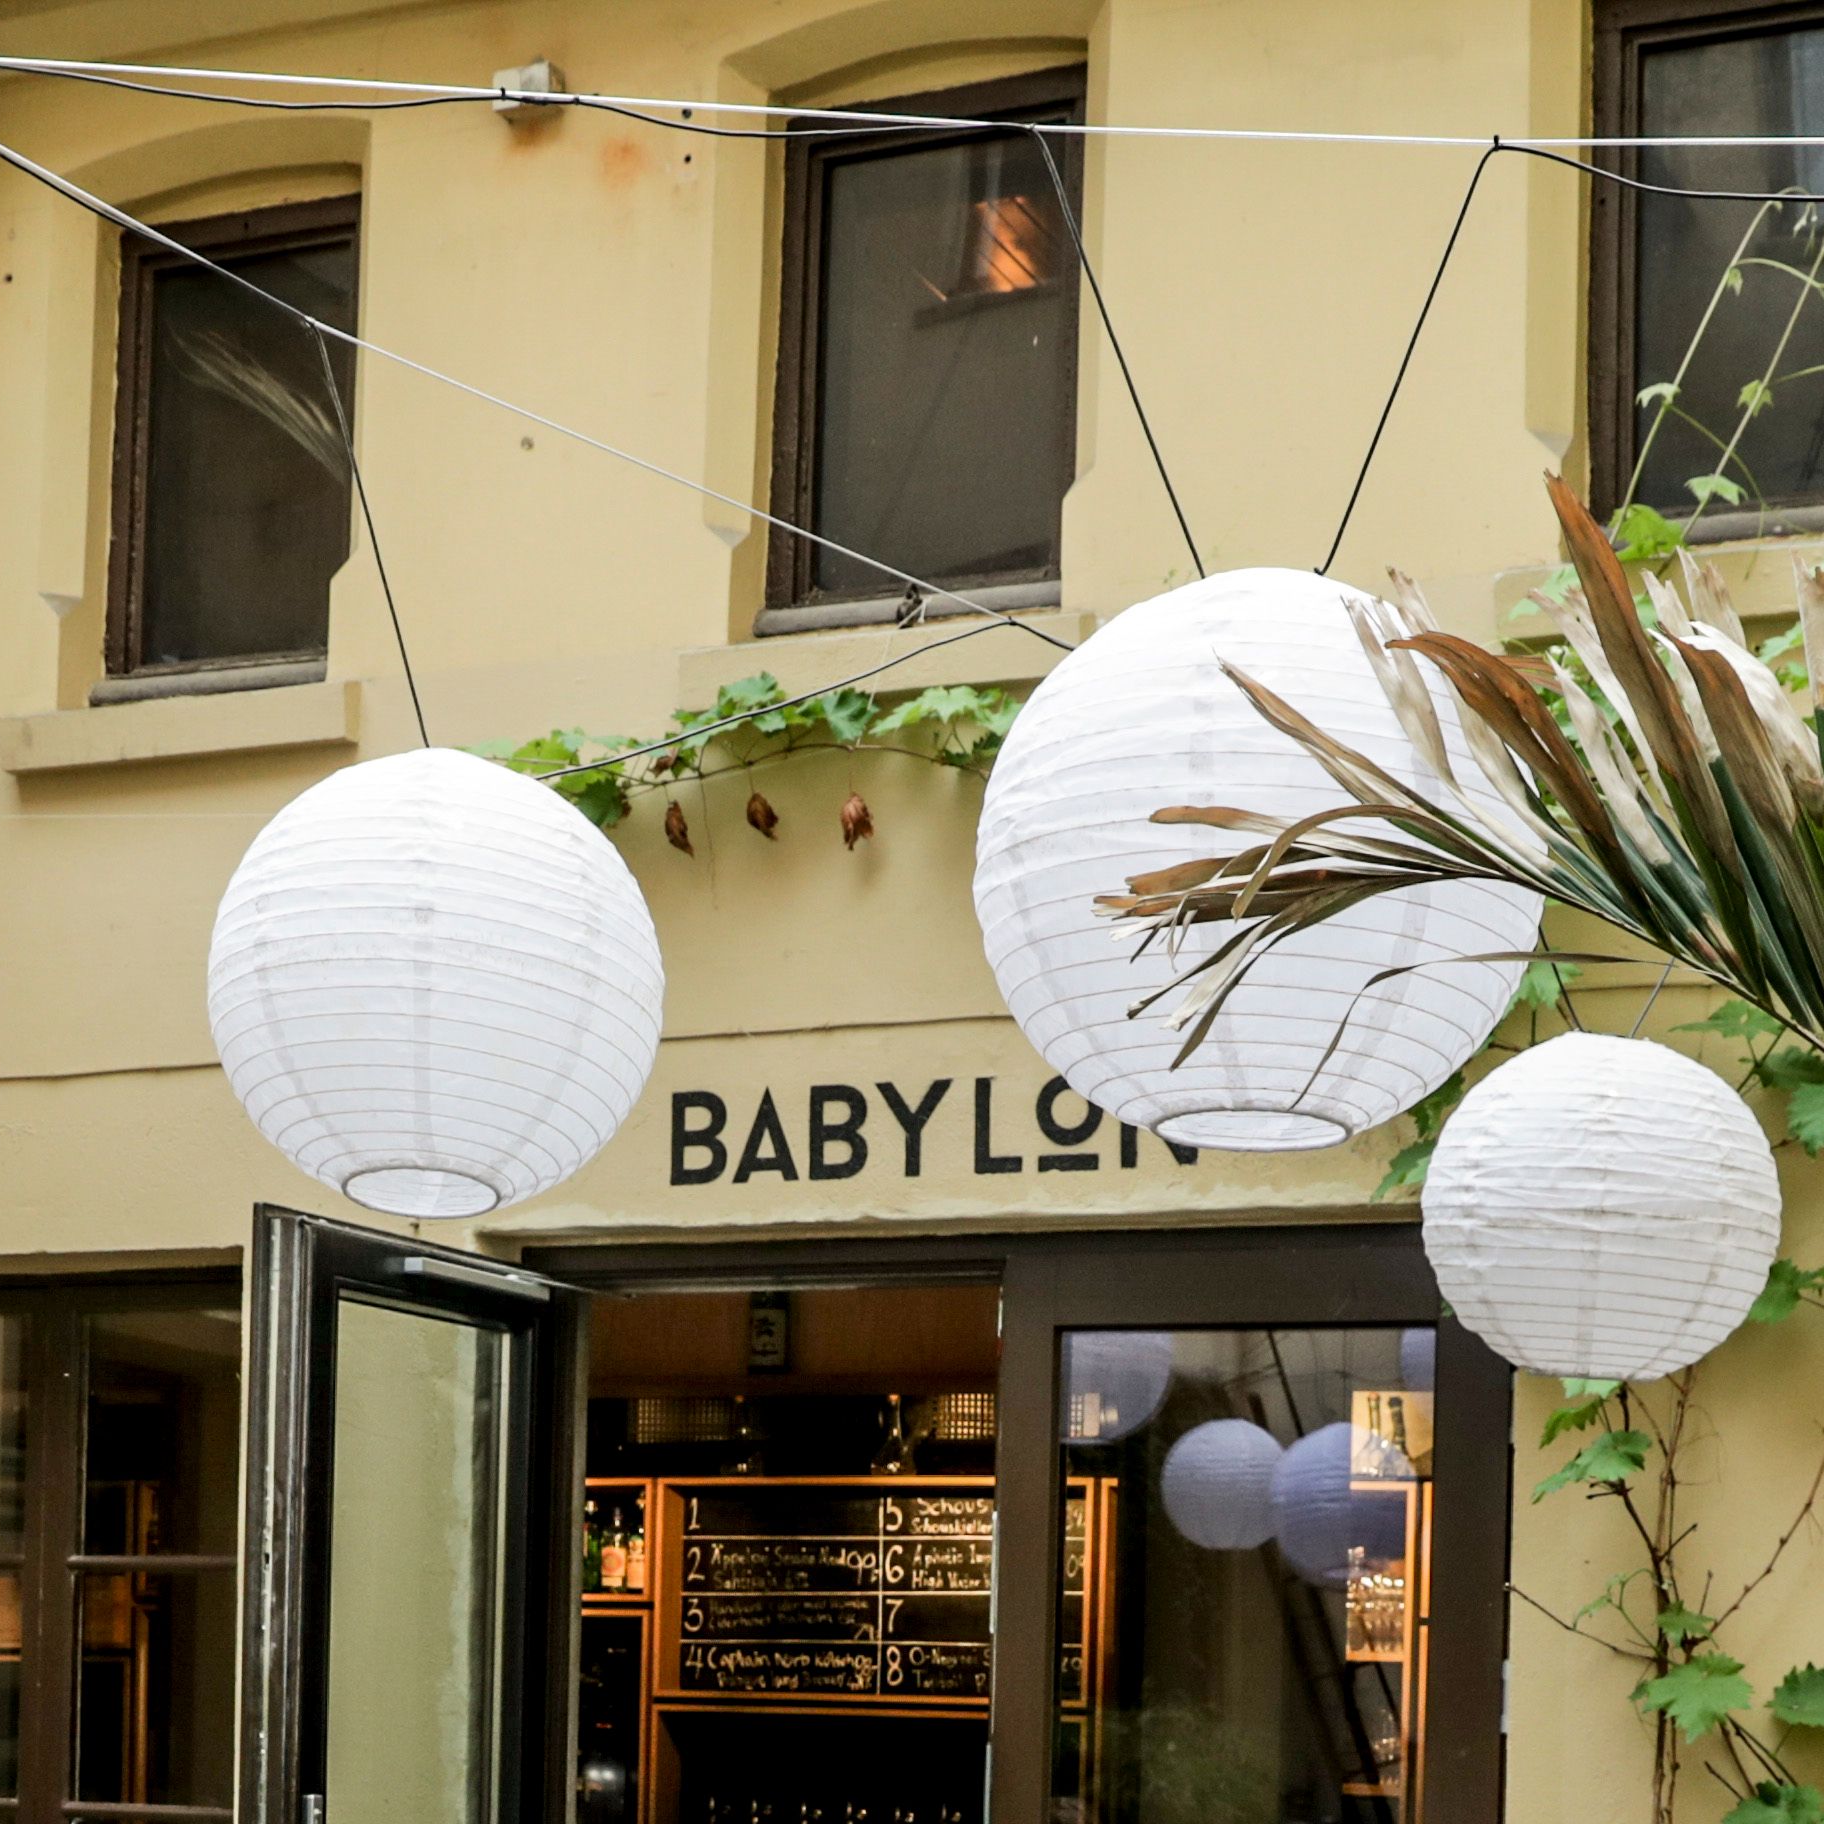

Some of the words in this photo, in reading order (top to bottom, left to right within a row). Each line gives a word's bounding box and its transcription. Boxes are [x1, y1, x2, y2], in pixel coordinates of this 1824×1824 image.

[670, 1075, 1198, 1185] BABYLO
[885, 1496, 903, 1532] 5
[687, 1547, 705, 1582] 2
[885, 1544, 904, 1584] 6
[683, 1597, 704, 1632] 3
[885, 1598, 904, 1634] 7
[684, 1644, 705, 1680] 4
[886, 1645, 904, 1686] 8
